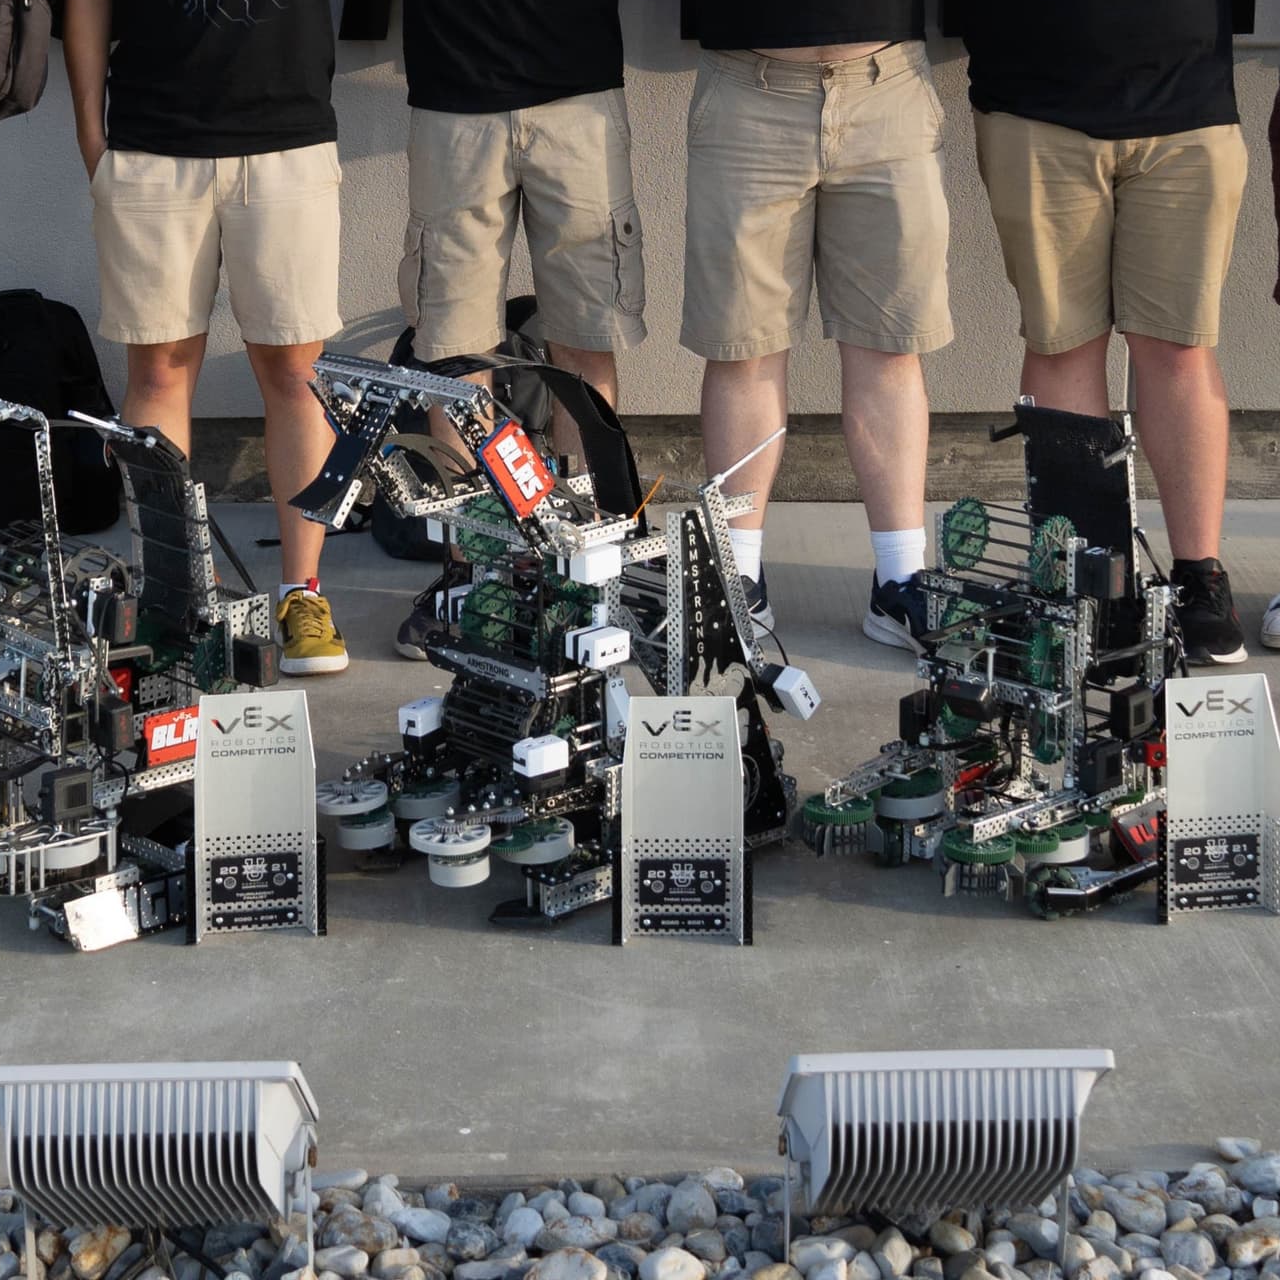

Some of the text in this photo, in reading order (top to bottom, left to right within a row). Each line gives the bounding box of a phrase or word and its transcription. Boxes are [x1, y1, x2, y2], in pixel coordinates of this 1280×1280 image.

[686, 519, 704, 654] ARMSTRONG
[467, 657, 510, 678] ARMSTRONG
[1176, 690, 1254, 717] VEX
[211, 706, 294, 734] VEX
[642, 711, 722, 736] VEX
[151, 717, 199, 751] BLR
[1175, 729, 1254, 740] COMPETITION
[211, 736, 296, 746] ROBOTICS
[640, 742, 725, 750] ROBOTICS
[211, 747, 296, 758] COMPETITION
[640, 752, 725, 760] COMPETITION
[220, 863, 287, 875] 20 21
[648, 870, 715, 878] 20 21
